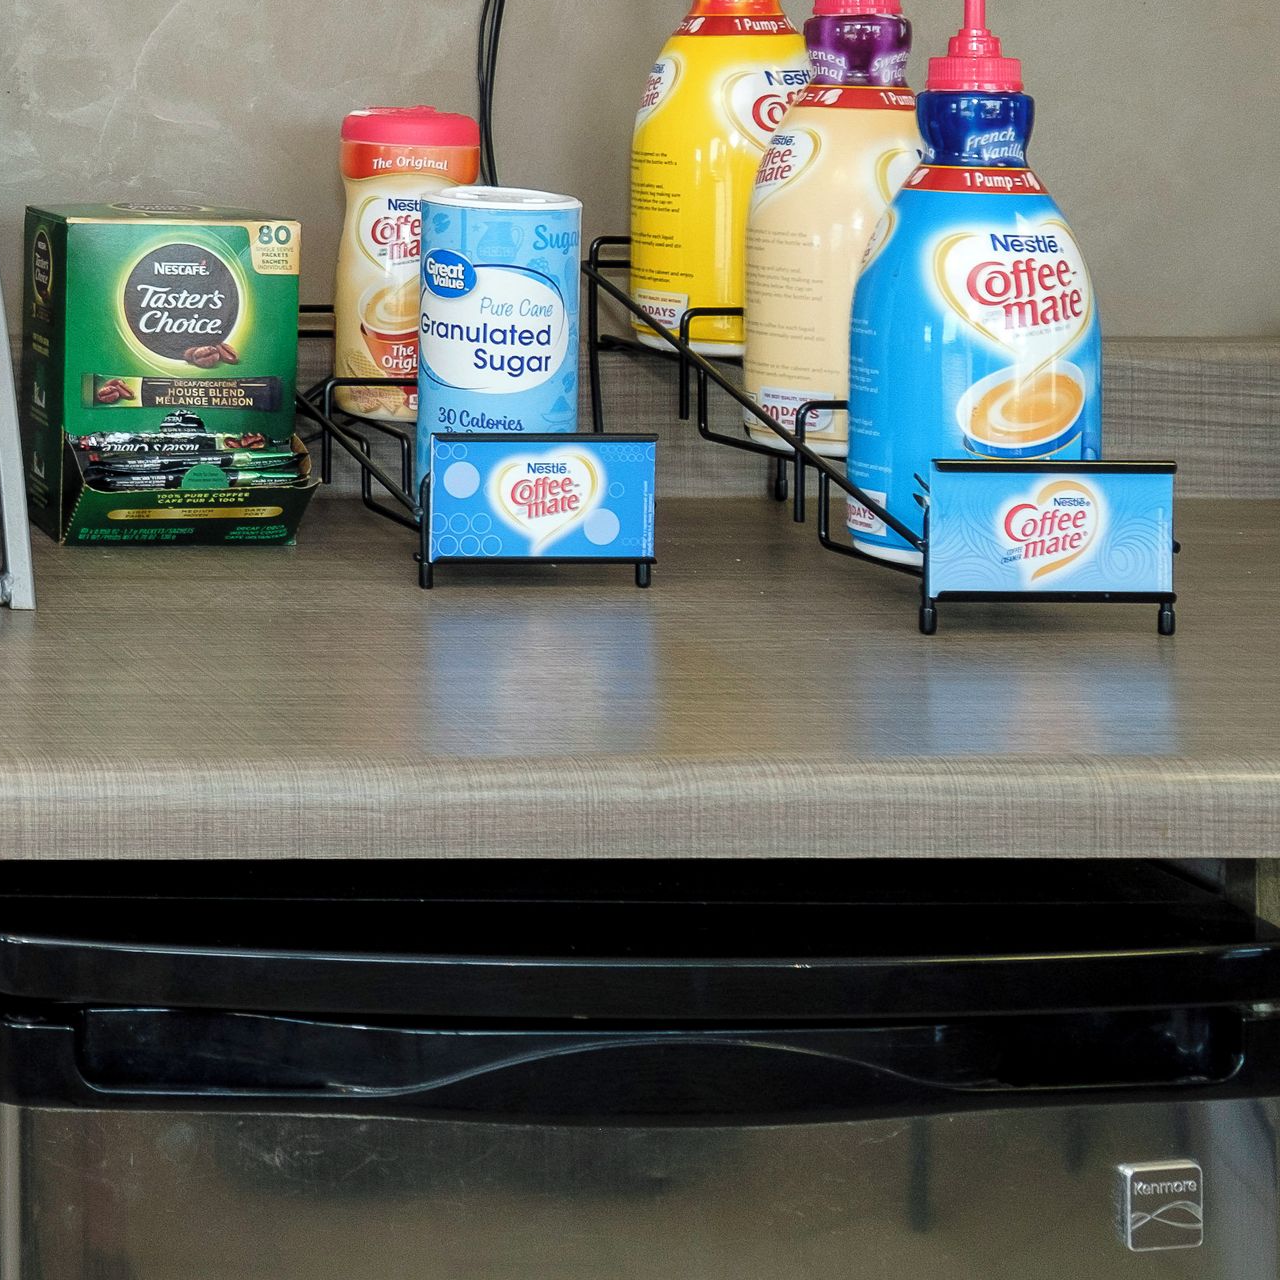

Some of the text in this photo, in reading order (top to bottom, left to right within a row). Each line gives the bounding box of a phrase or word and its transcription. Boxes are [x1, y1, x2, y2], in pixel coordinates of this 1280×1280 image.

[965, 128, 1015, 152] French
[373, 156, 448, 171] The Original
[964, 173, 972, 186] 1
[258, 225, 291, 245] 80
[533, 225, 578, 255] Suga
[990, 233, 1058, 253] Nestlé
[388, 239, 420, 260] ma
[426, 257, 464, 278] Great
[433, 276, 464, 290] Value
[137, 284, 225, 309] Taster's
[480, 296, 553, 317] Pure Cane
[1003, 288, 1082, 330] mate
[421, 313, 551, 346] Granulated
[391, 344, 414, 356] The
[382, 356, 418, 373] Origi
[474, 348, 551, 378] Sugar
[168, 388, 245, 397] HOUSE BLEND
[211, 397, 254, 406] MAISON
[438, 407, 525, 432] 30 Calories
[527, 463, 567, 474] Nestlé
[527, 494, 579, 519] mate
[1054, 498, 1085, 506] Nestlé
[1005, 503, 1087, 542] Coffee
[1024, 532, 1082, 559] mate
[1134, 1180, 1197, 1196] Kenmore
